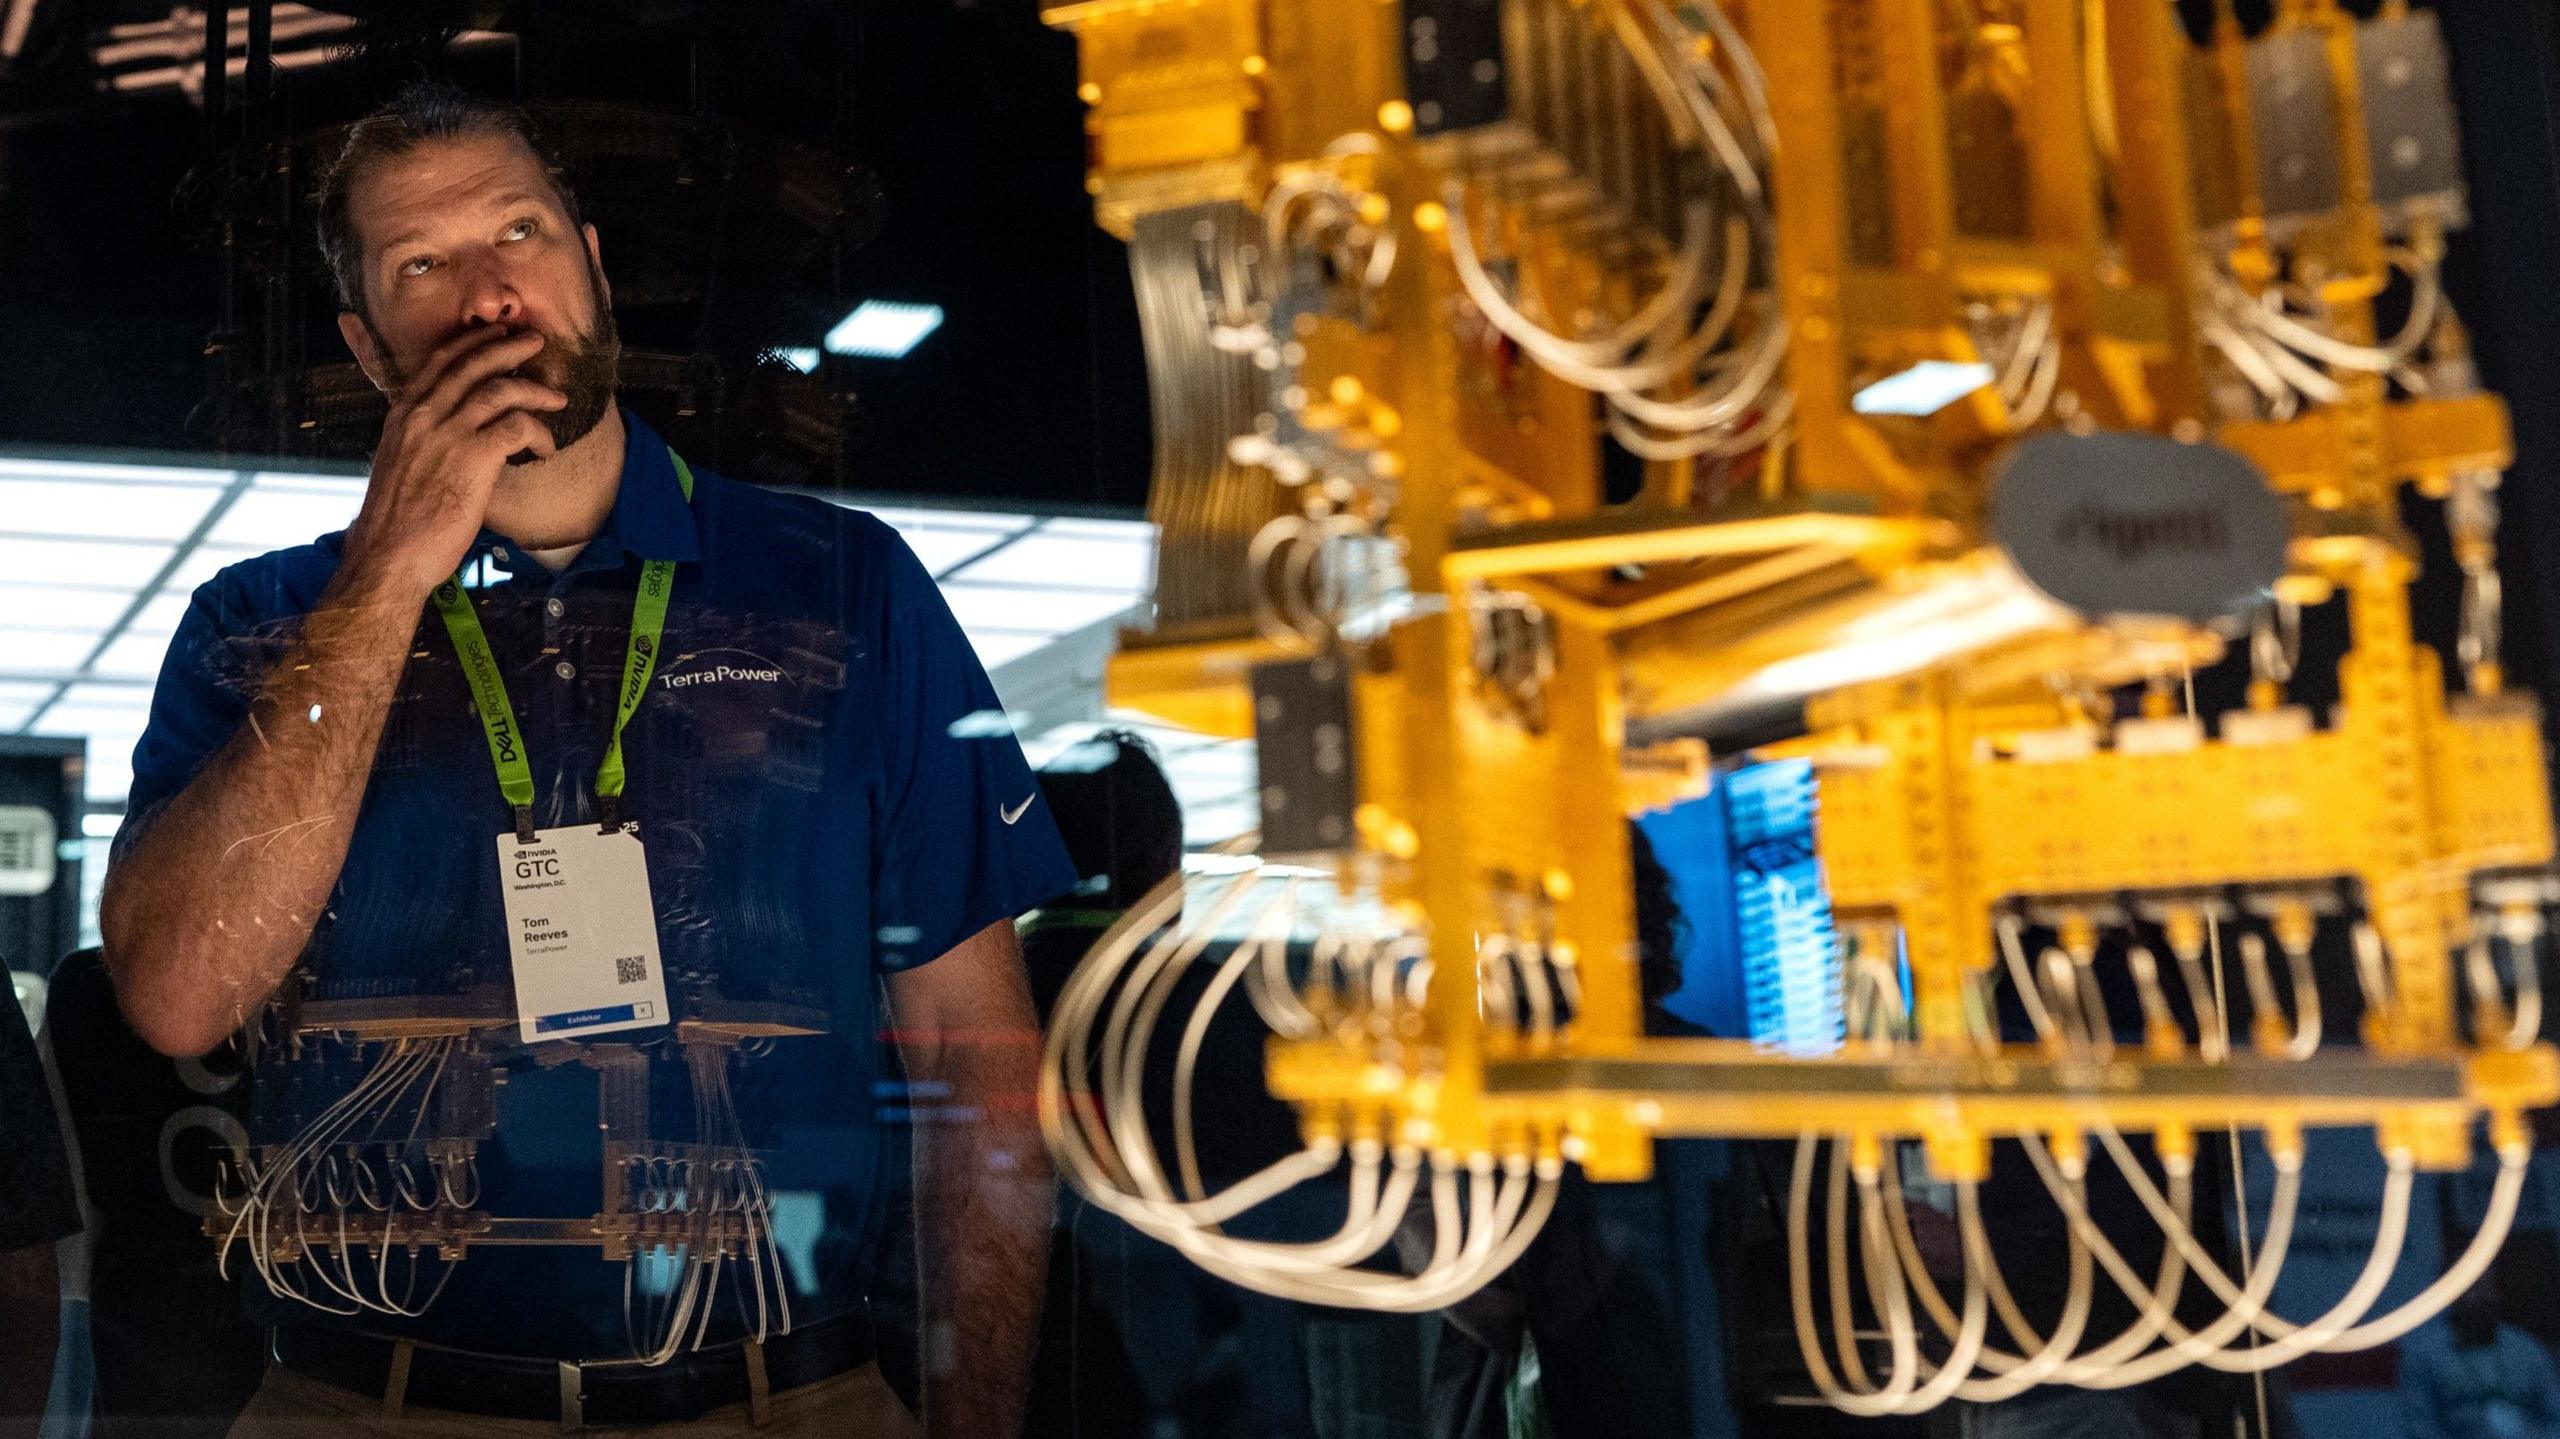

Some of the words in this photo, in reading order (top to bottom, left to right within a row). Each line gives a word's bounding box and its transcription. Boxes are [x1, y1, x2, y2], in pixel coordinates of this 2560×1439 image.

[466, 640, 503, 718] Technologies
[659, 666, 781, 688] TerraPower
[491, 717, 517, 763] DELL
[516, 859, 560, 878] GTC
[513, 882, 553, 890] Washington,
[521, 918, 549, 928] Tom
[524, 930, 568, 942] Reeves
[526, 945, 568, 954] TerraPower
[567, 1014, 601, 1024] Exhibitor
